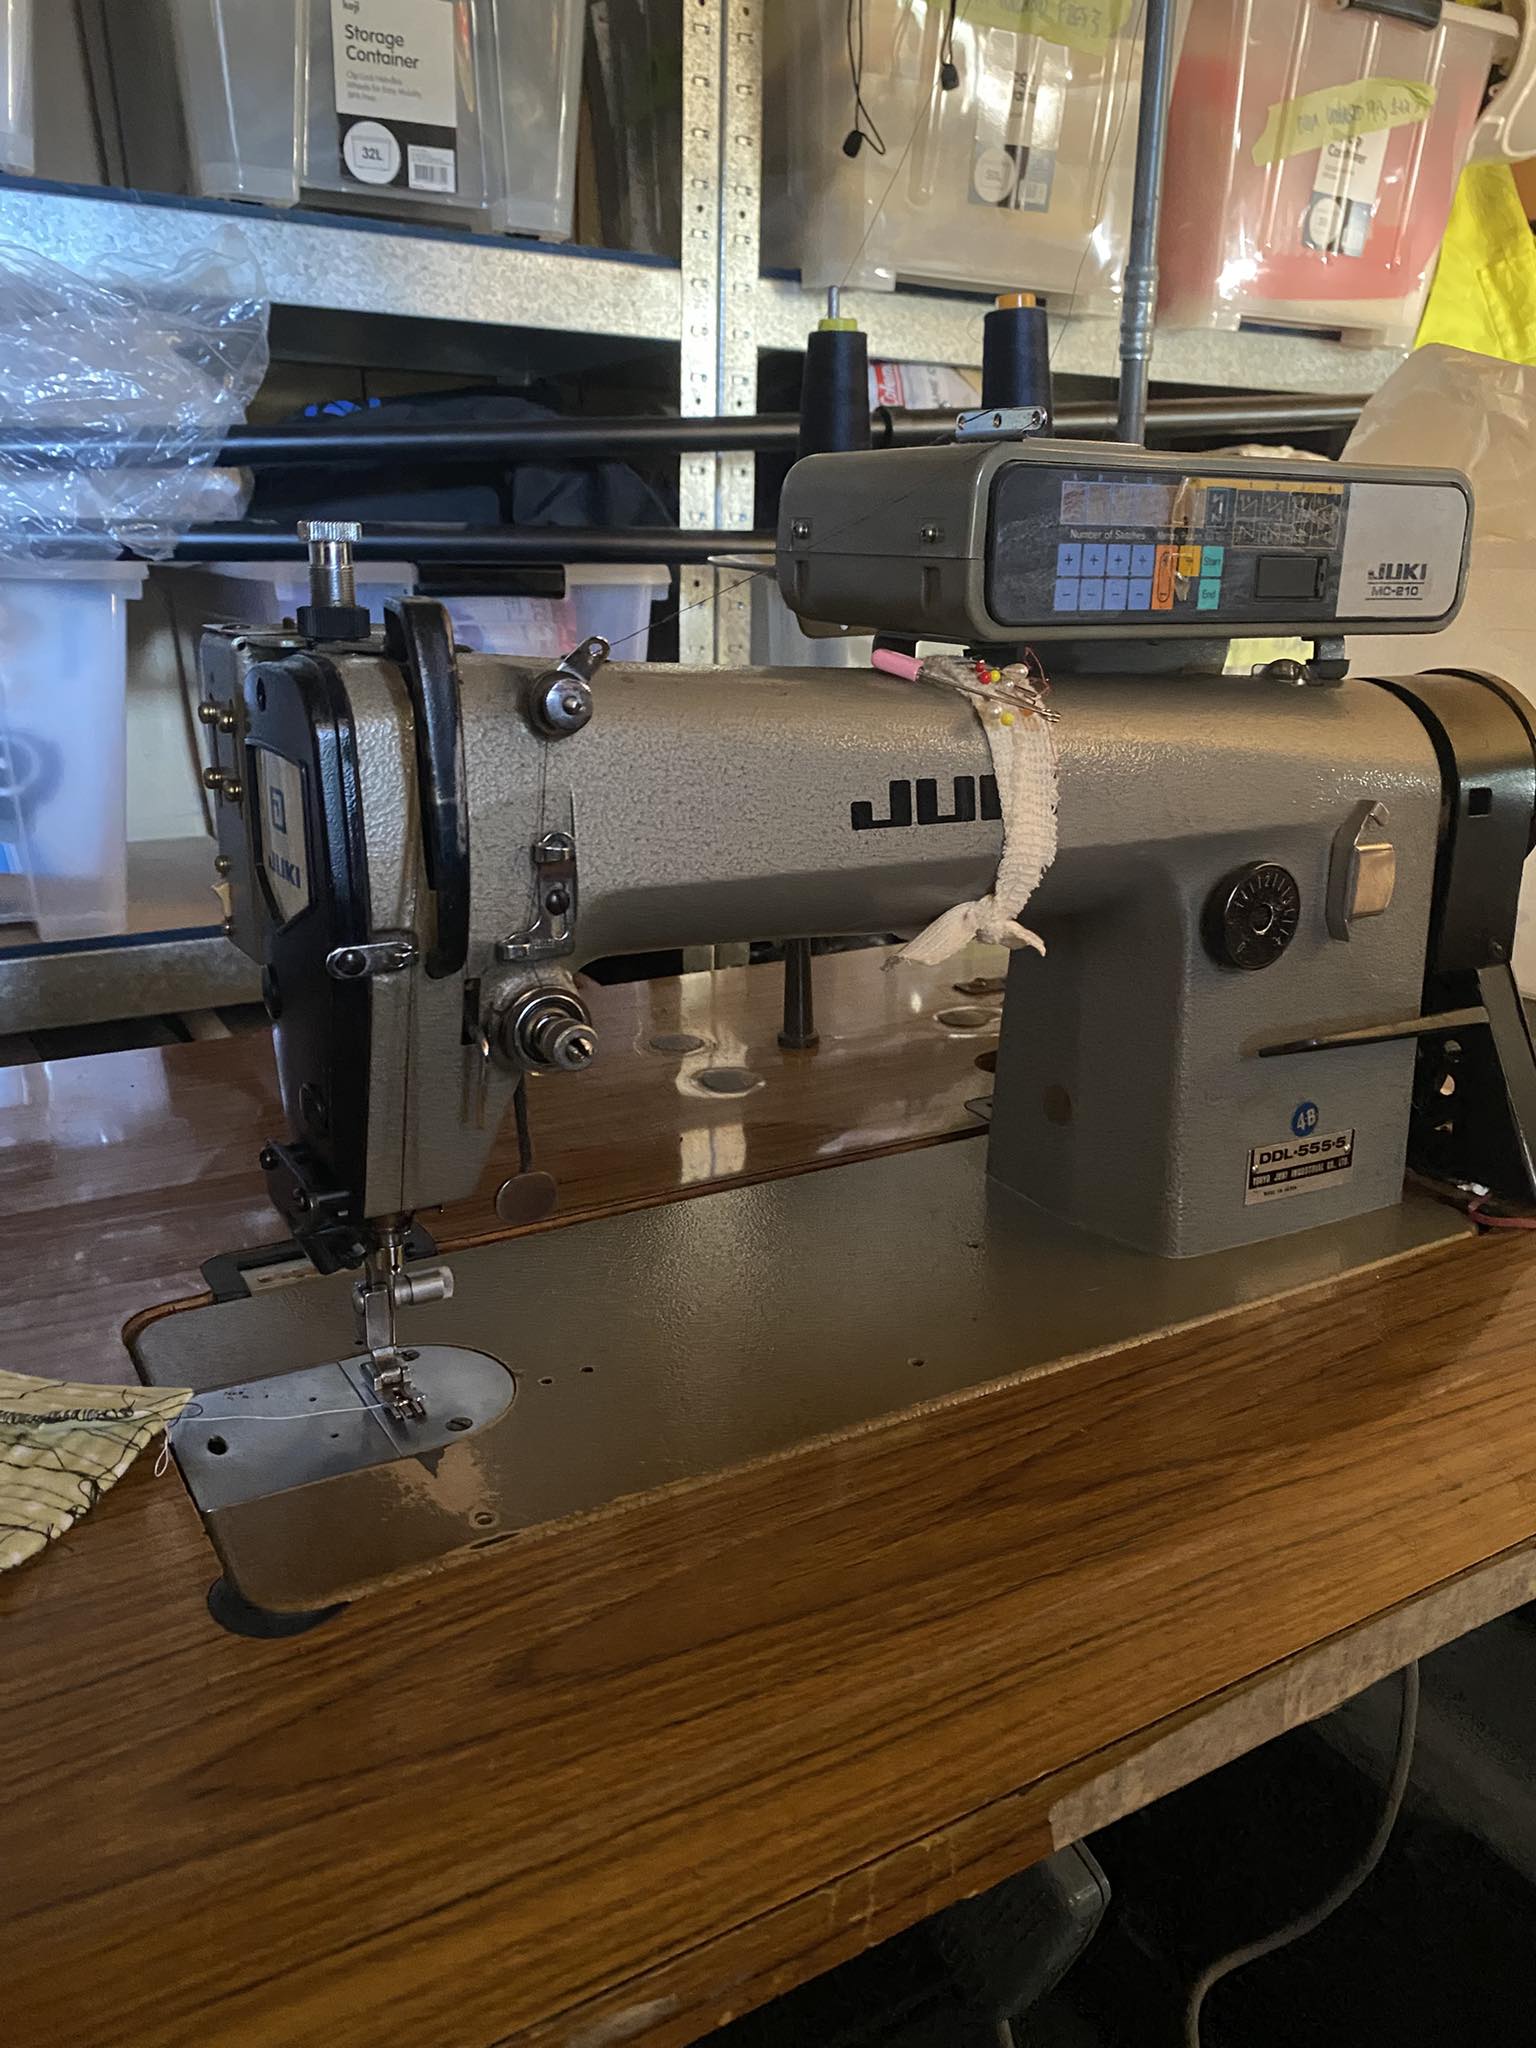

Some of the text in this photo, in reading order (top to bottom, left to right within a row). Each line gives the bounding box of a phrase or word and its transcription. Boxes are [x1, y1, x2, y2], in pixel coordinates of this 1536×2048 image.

[344, 23, 405, 51] Storage
[345, 45, 420, 69] Container
[361, 147, 383, 161] 32L
[1367, 563, 1428, 580] JUKI
[1371, 586, 1419, 596] MC-210
[268, 851, 302, 889] JUKI
